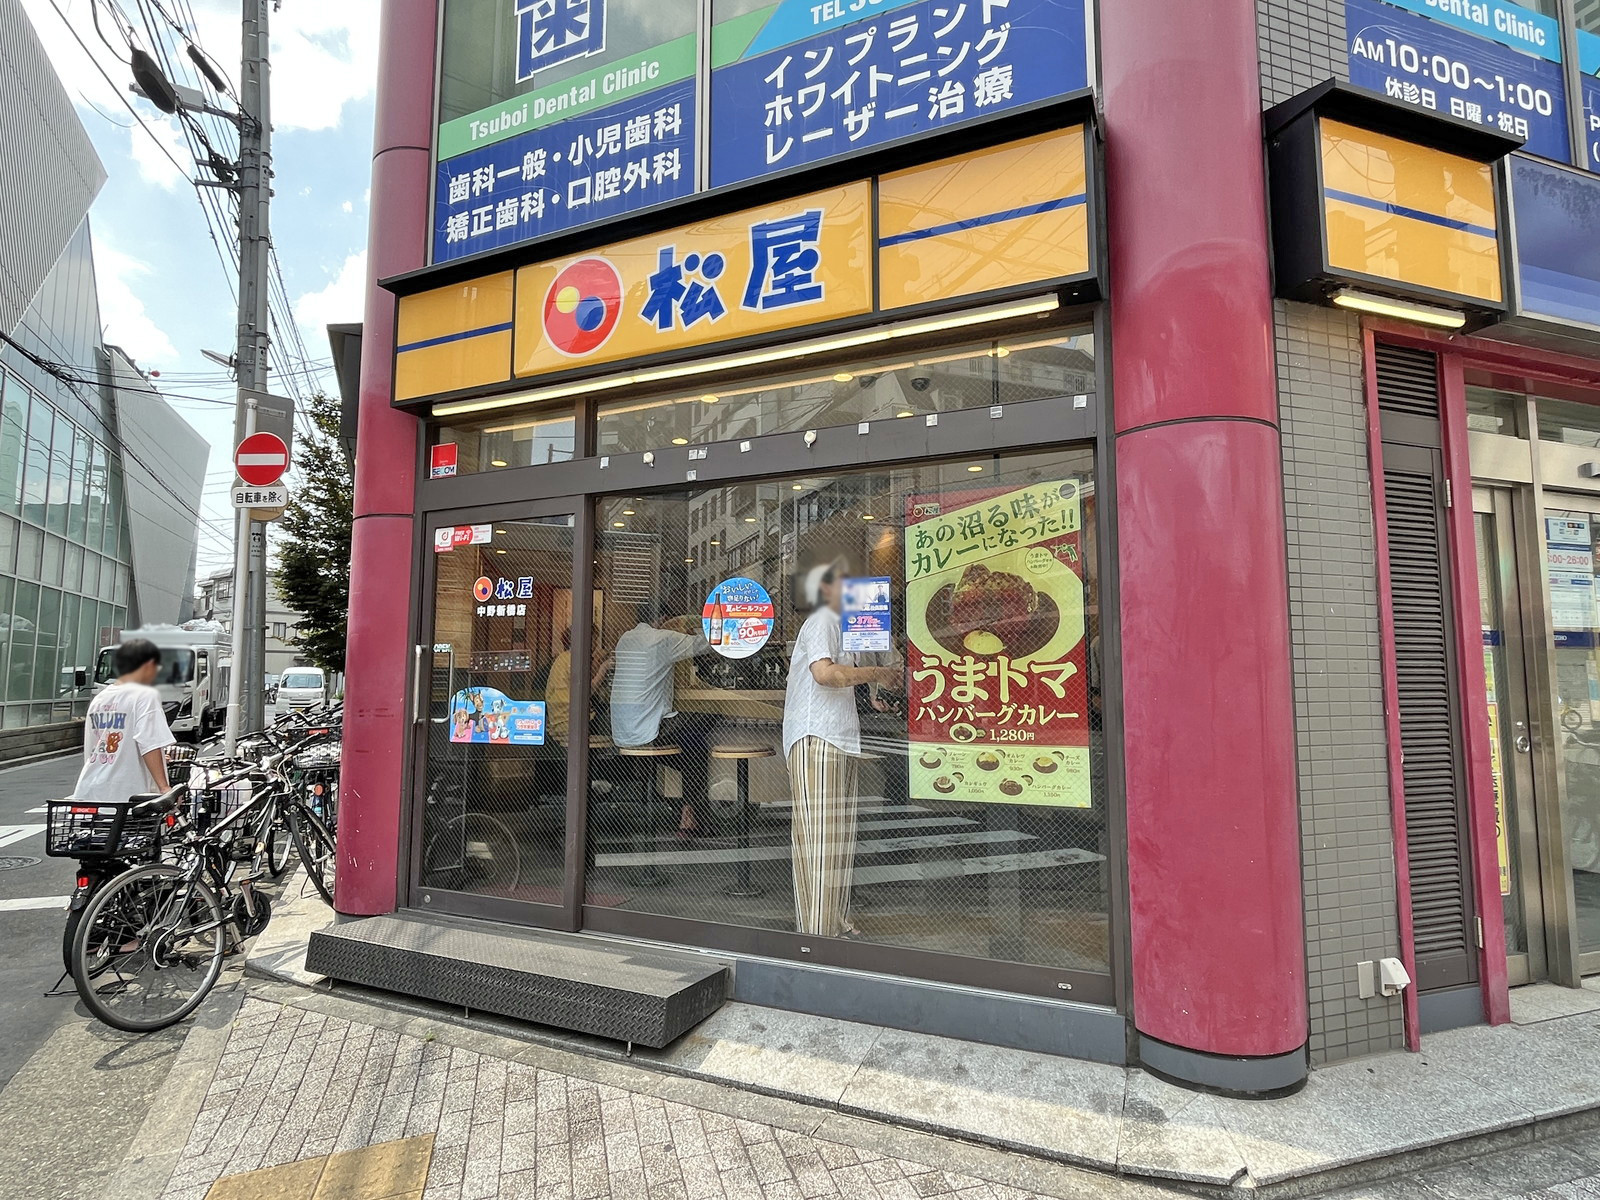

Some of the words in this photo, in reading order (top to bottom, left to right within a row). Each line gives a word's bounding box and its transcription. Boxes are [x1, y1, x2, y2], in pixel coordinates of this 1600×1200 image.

[810, 1, 846, 25] TEL
[1425, 0, 1489, 26] ental
[1494, 8, 1546, 47] Clinic
[764, 0, 1009, 89] インプラント
[470, 104, 528, 141] Tsuboi
[534, 79, 596, 119] Dental
[602, 61, 660, 95] Clinic
[763, 22, 1010, 127] ホワイトニング
[766, 65, 1013, 164] レーザー治療
[1385, 77, 1437, 110] 休診日
[1450, 101, 1529, 139] 日曜・祝日
[449, 104, 682, 204] 歯科一般・小児歯科
[446, 148, 681, 244] 矯正歯科・口腔外科
[637, 207, 825, 333] 松屋
[236, 491, 282, 504] 自転車を除く
[915, 490, 1059, 549] あの沼る味が
[477, 604, 526, 618] 中野新橋店
[495, 576, 533, 599] 松屋
[913, 656, 1077, 703] うまトマ
[916, 703, 1079, 726] ハンバーグカレー
[990, 728, 1035, 741] 1,280円
